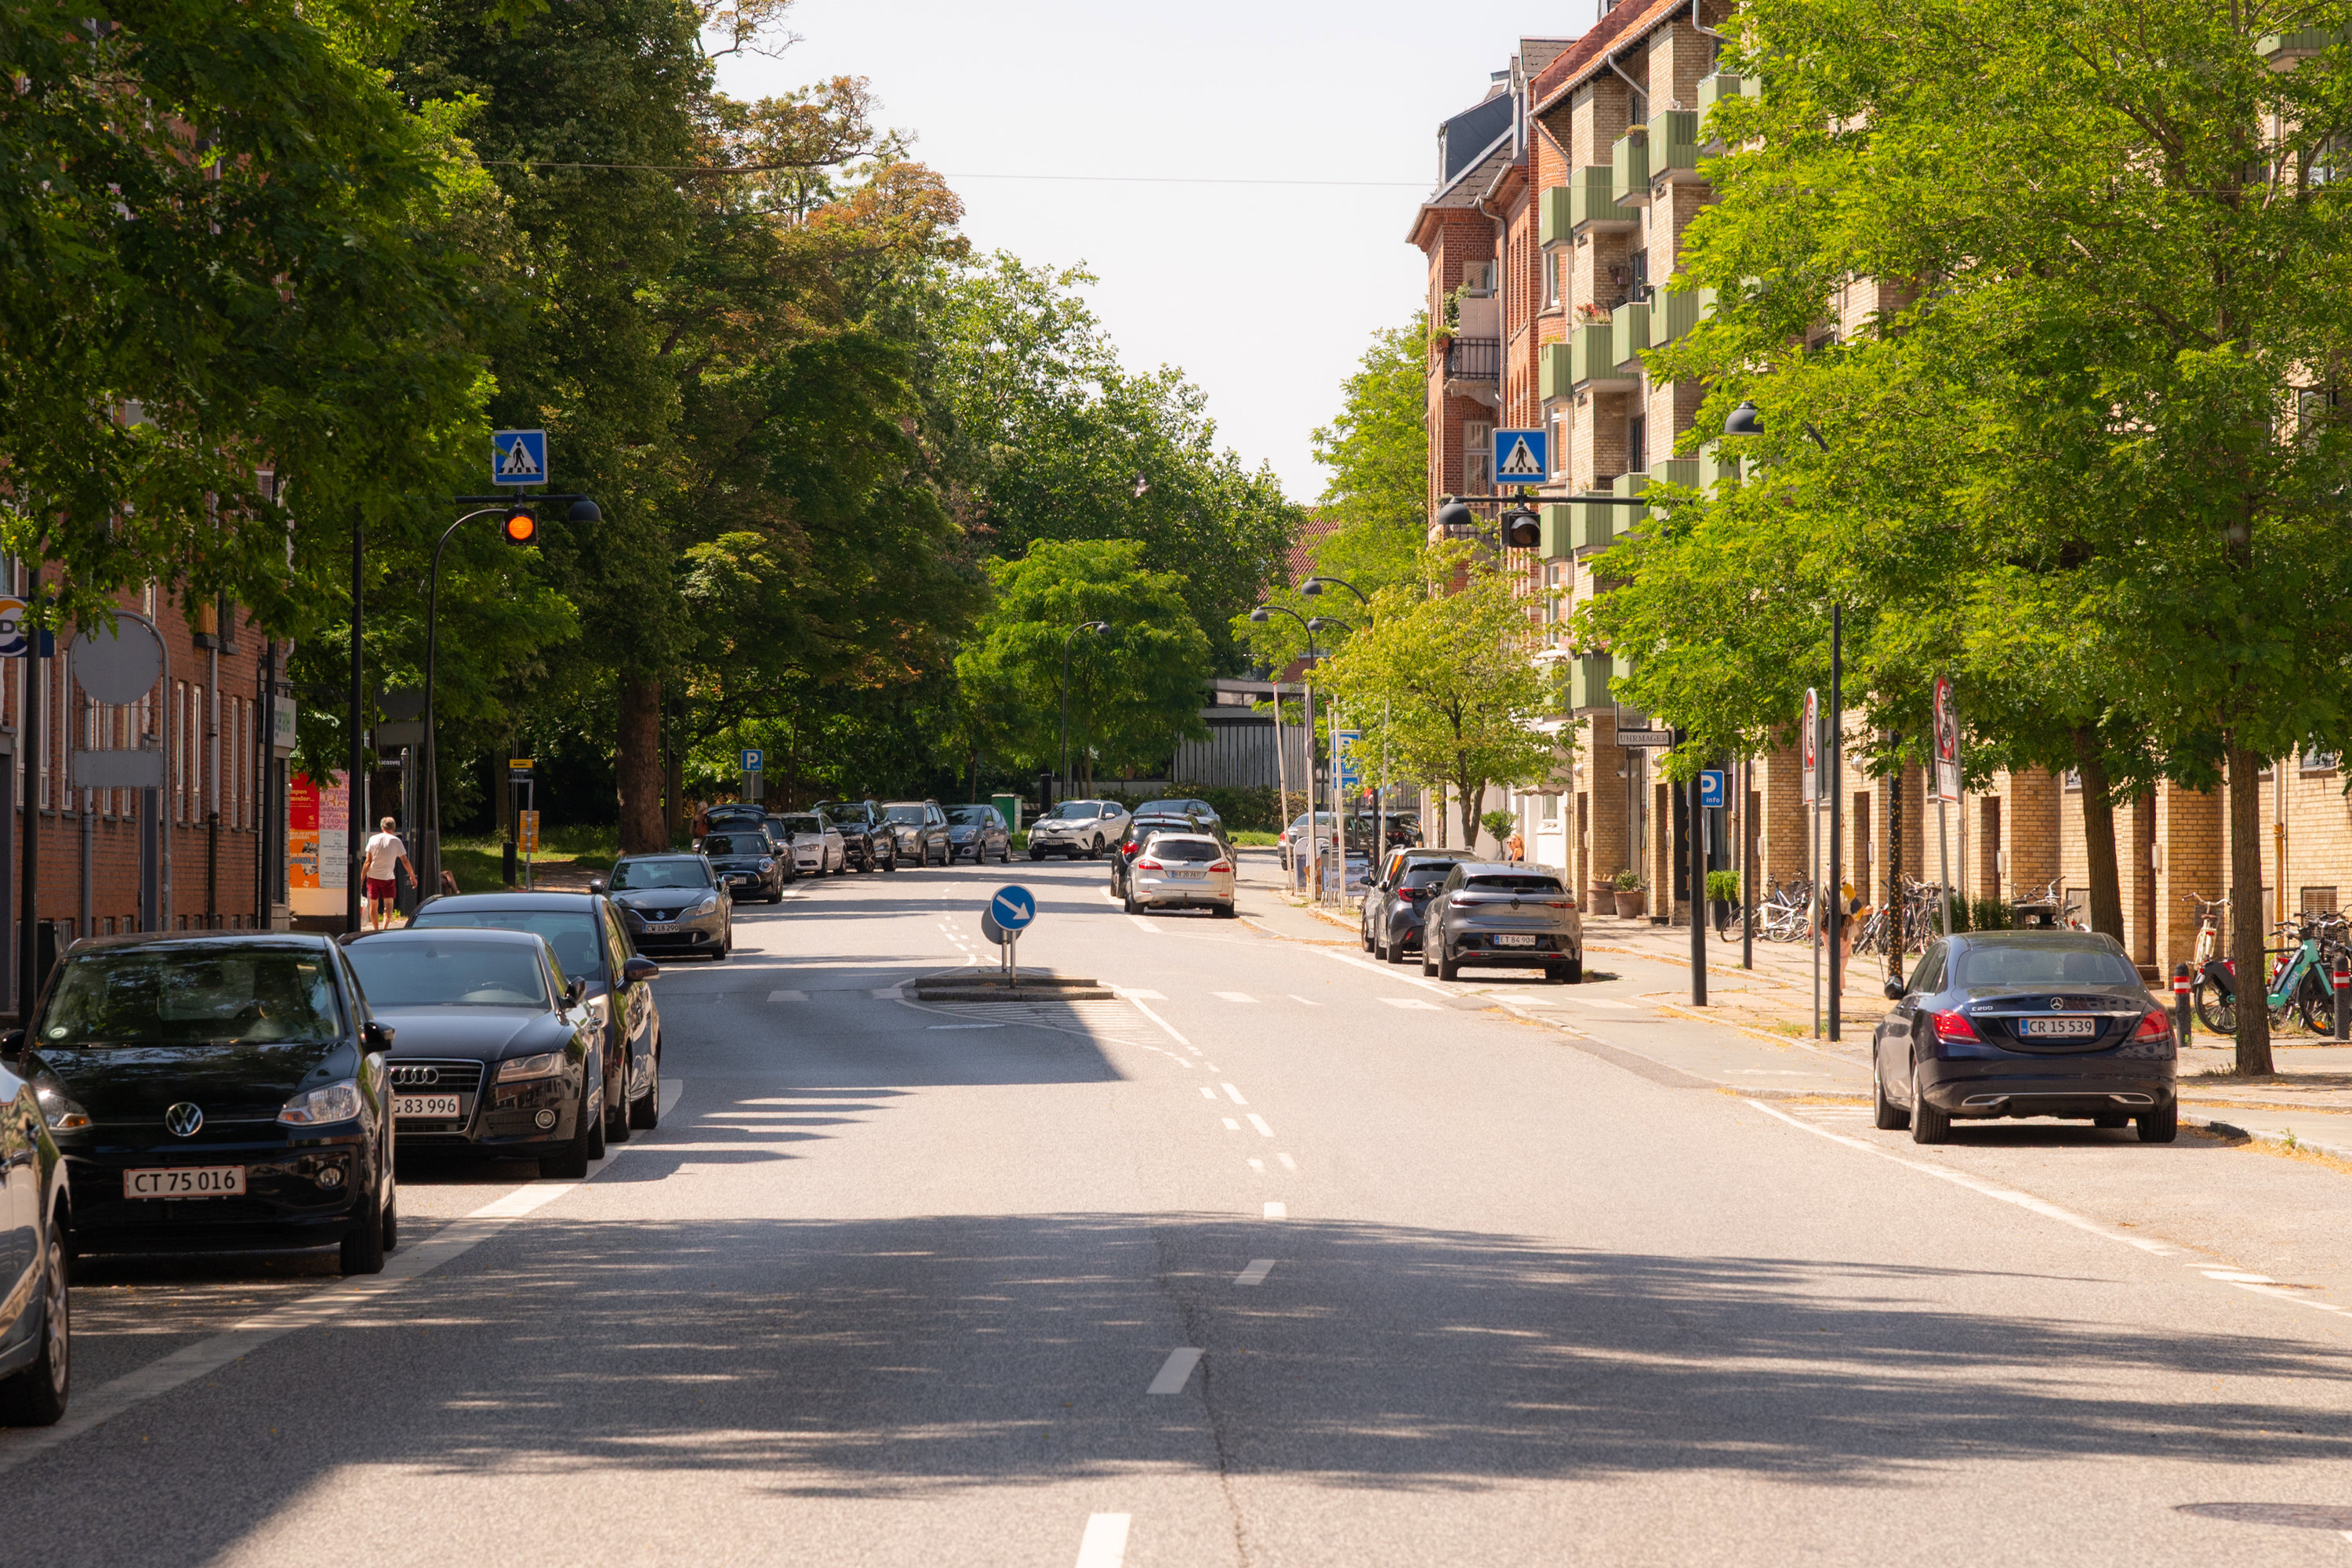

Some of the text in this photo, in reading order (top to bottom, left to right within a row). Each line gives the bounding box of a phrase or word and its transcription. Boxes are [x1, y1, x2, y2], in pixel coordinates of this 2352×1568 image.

[746, 752, 759, 769] P
[2286, 971, 2300, 990] dott
[2029, 1021, 2092, 1033] CR 15 539
[405, 1099, 423, 1113] 83
[427, 1098, 456, 1113] 996
[135, 1171, 235, 1192] CT 75 016
